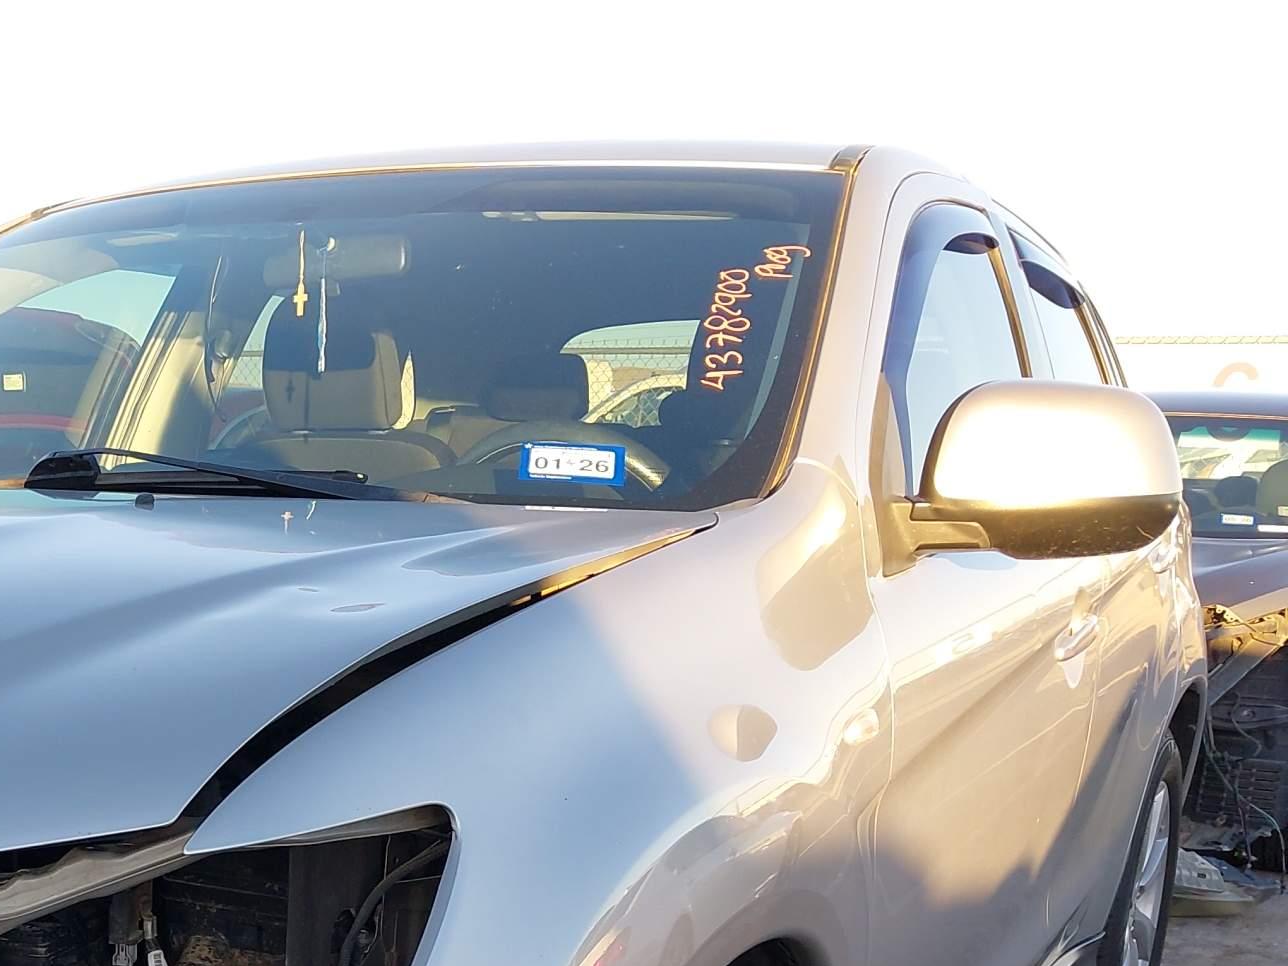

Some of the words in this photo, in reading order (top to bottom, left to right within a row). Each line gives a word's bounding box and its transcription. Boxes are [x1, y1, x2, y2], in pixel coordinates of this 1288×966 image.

[699, 267, 753, 391] 43782900
[534, 456, 562, 470] 01
[578, 459, 610, 473] 26
